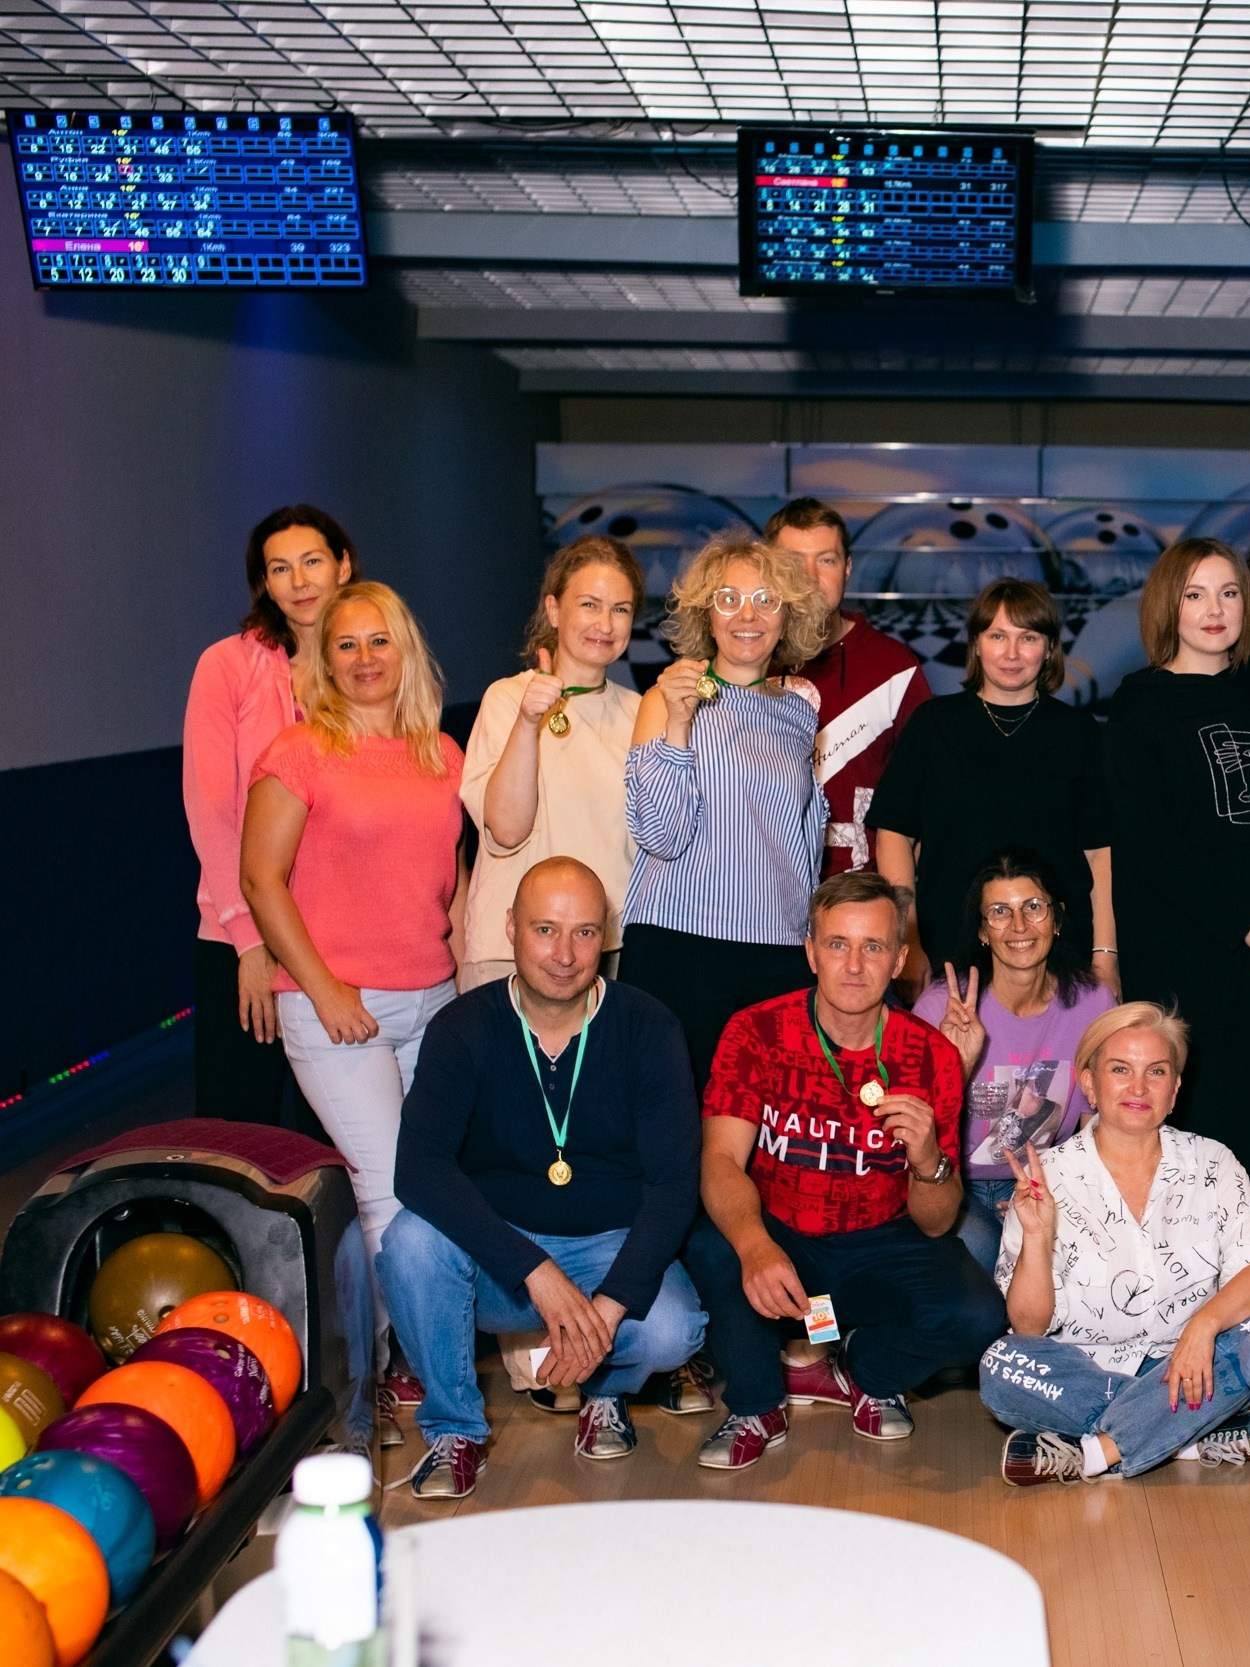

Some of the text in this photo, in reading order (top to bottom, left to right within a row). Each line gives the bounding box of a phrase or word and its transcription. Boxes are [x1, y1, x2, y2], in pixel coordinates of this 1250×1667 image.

[960, 182, 972, 190] 31
[766, 199, 875, 213] 8 14 21 28 31
[65, 241, 101, 251] Елена
[290, 242, 350, 253] 39 323
[56, 255, 63, 267] 5
[73, 255, 79, 267] 7
[104, 255, 111, 267] 8
[136, 255, 143, 267] 3
[167, 255, 174, 268] 3
[181, 255, 188, 268] 4
[51, 268, 187, 283] 5 12 20 23 30
[758, 1122, 908, 1176] MIL
[1153, 1240, 1190, 1282] LOVE
[1005, 1349, 1052, 1376] ever
[1002, 1366, 1064, 1401] Always
